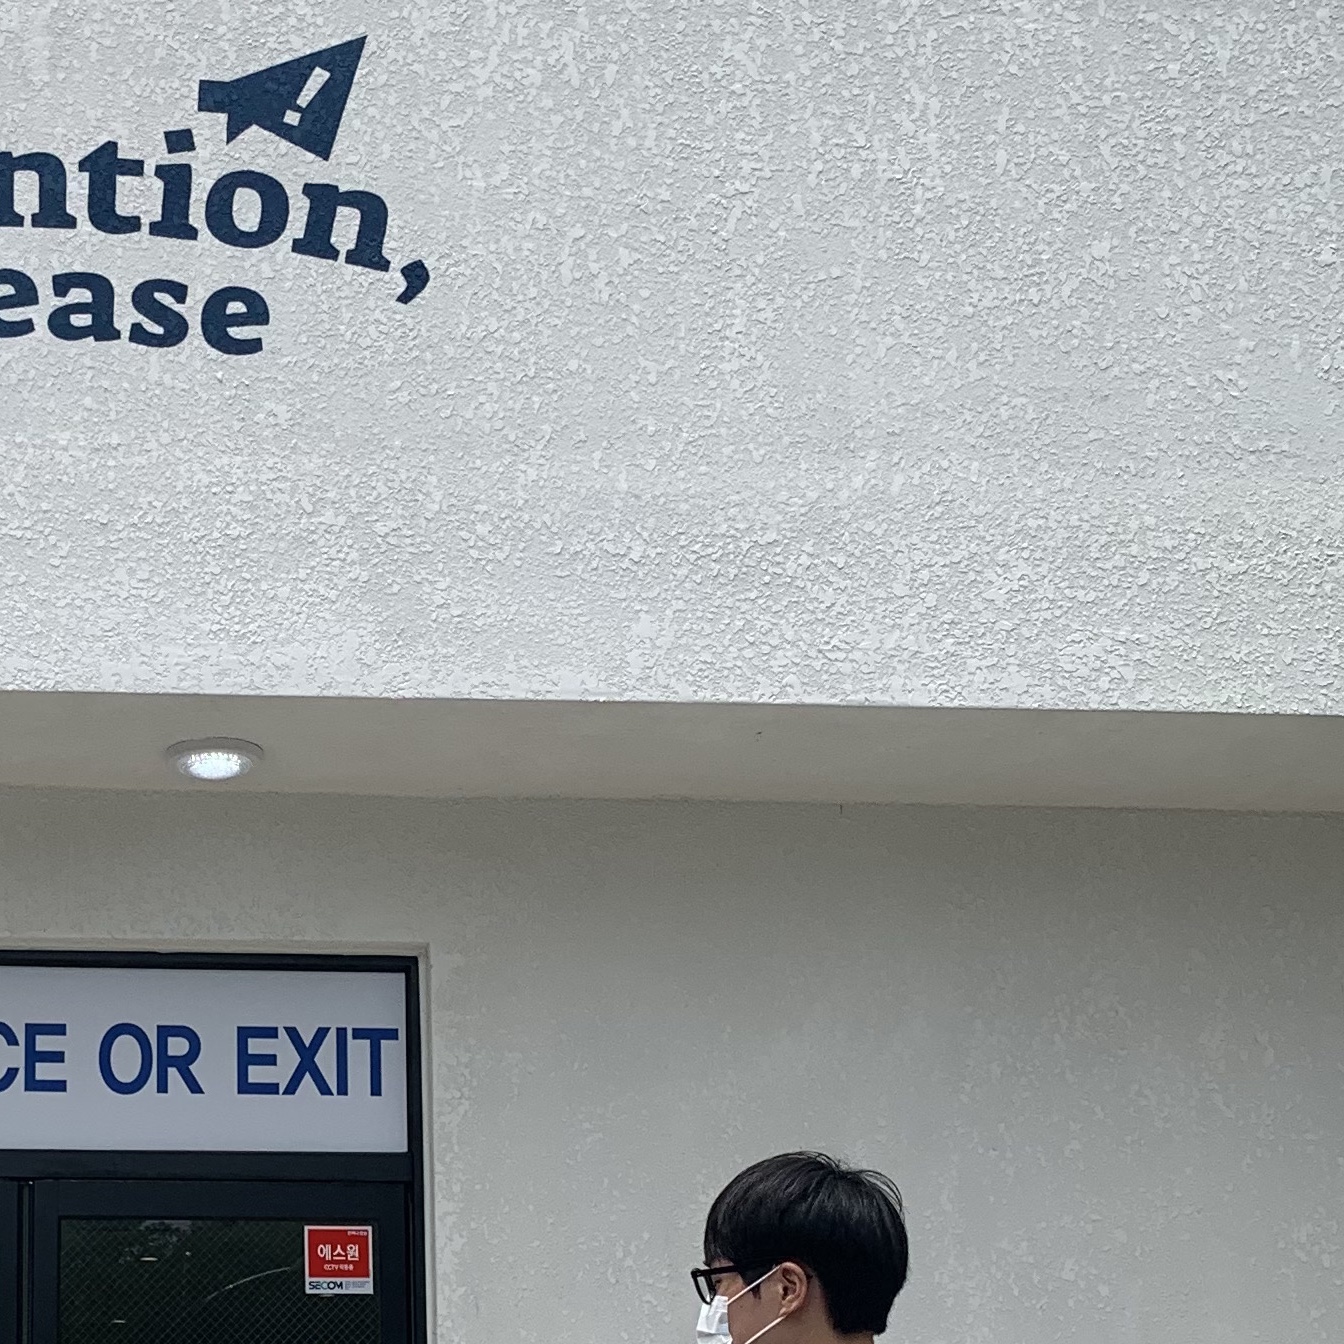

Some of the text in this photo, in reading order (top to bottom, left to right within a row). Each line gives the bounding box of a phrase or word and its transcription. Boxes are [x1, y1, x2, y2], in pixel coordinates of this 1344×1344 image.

[98, 1022, 205, 1095] OR
[235, 1026, 400, 1097] EXIT
[317, 1244, 360, 1261] 에스원
[308, 1281, 344, 1290] SECOM
